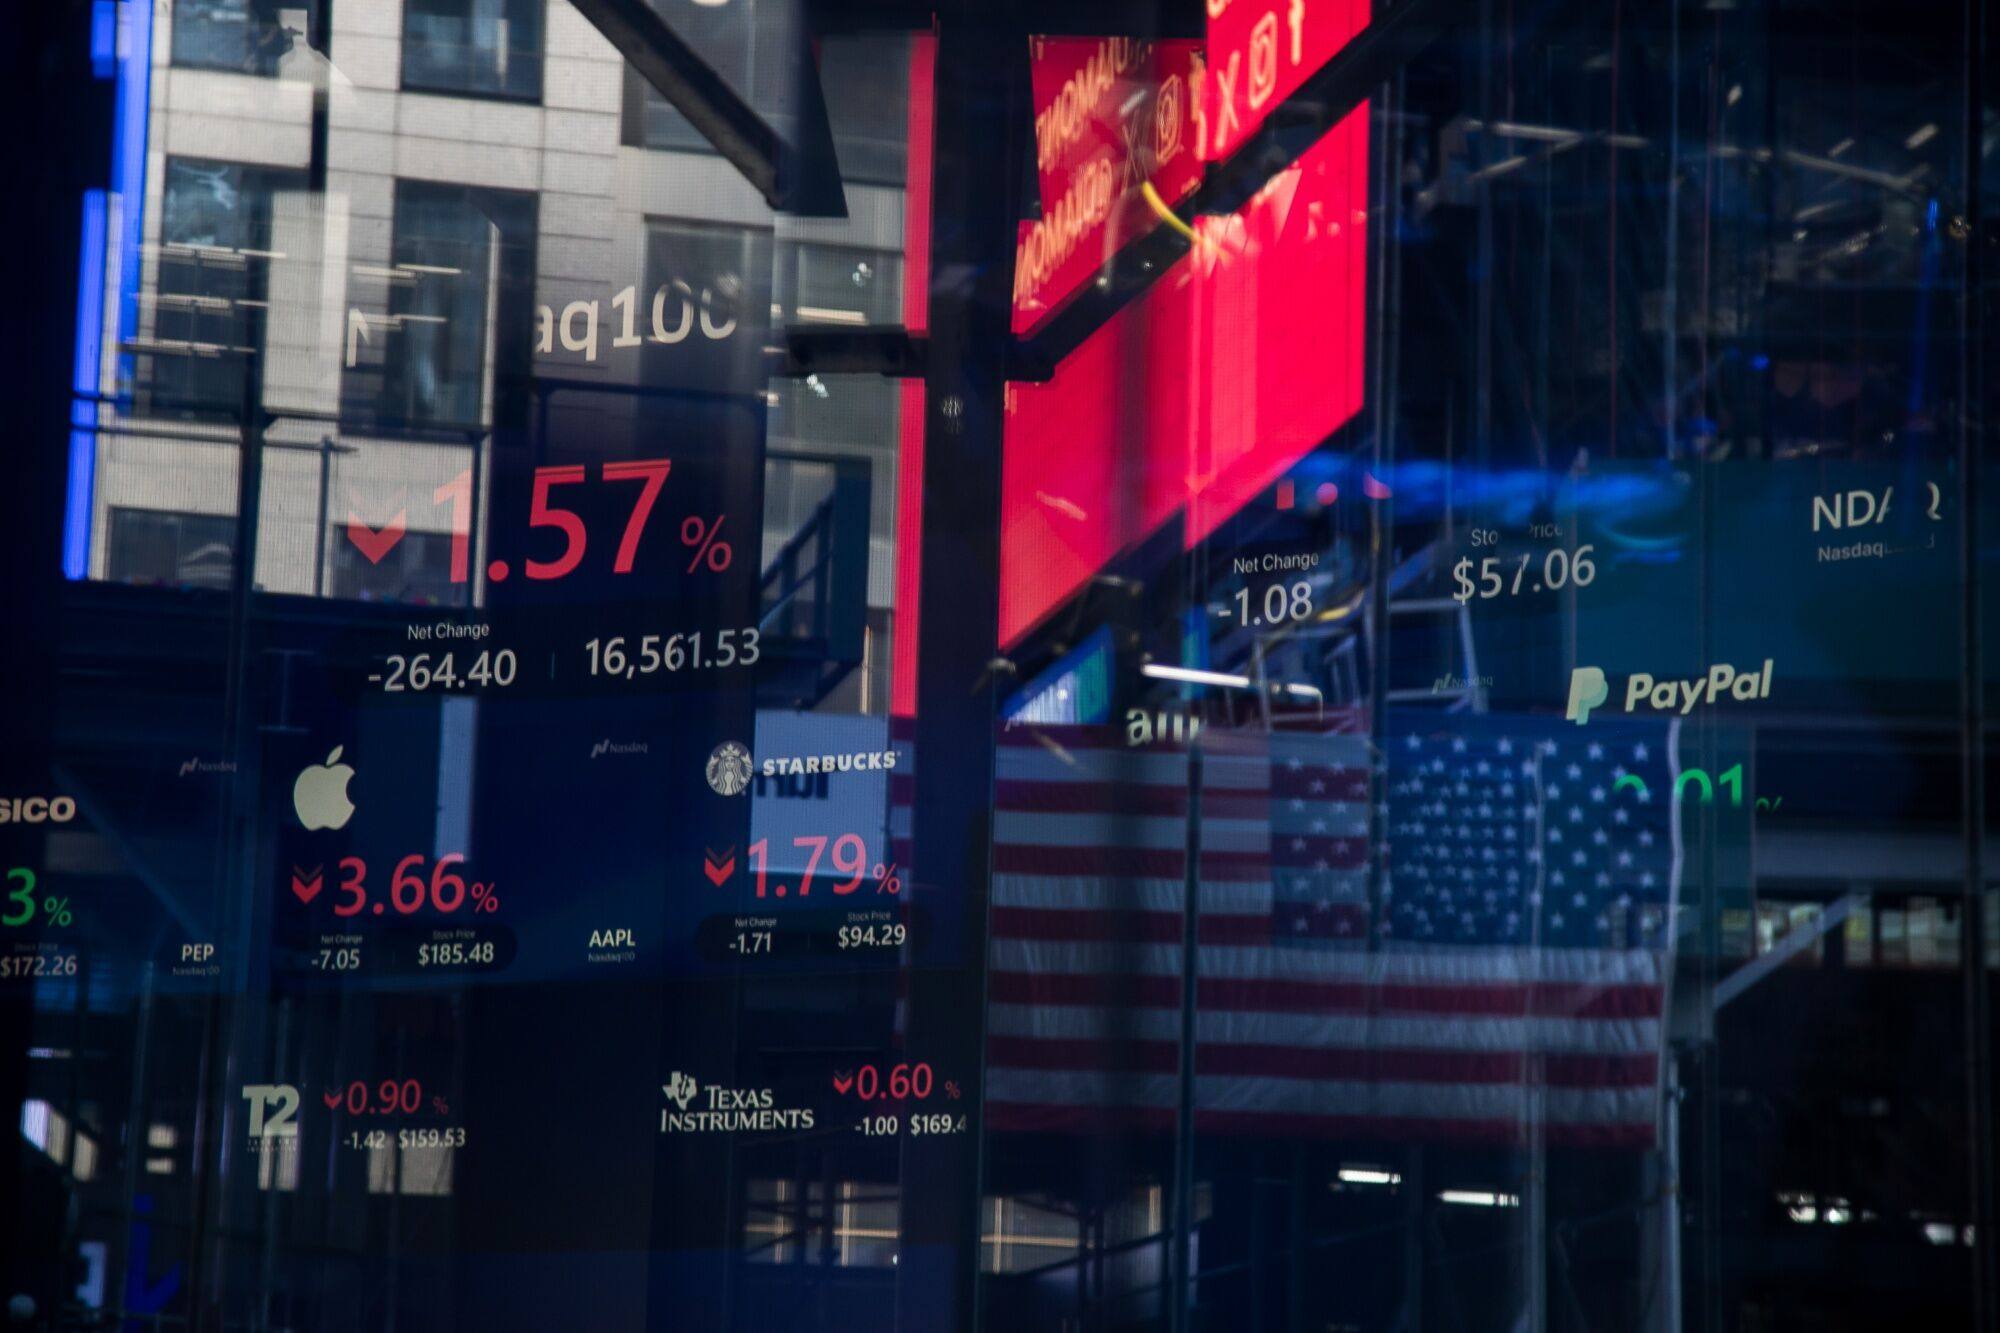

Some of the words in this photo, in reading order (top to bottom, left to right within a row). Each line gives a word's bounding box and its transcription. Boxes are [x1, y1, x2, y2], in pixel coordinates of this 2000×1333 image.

[1233, 556, 1259, 574] Net
[1262, 551, 1319, 571] Change
[1218, 581, 1313, 627] -1.08
[407, 624, 432, 640] Net
[435, 622, 490, 640] Change
[584, 626, 760, 680] 16,561.53
[367, 648, 517, 692] -264.40
[1625, 658, 1774, 715] PayPal
[762, 751, 896, 776] STARBUCKS
[749, 916, 777, 928] Change
[588, 928, 636, 948] AAPL
[728, 931, 772, 954] -1.71
[837, 924, 906, 951] $94.29
[181, 943, 215, 962] PEP
[311, 947, 360, 970] -7.05
[418, 940, 494, 968] $185.48
[0, 954, 77, 978] $172.26
[856, 1063, 933, 1100] 0.60
[346, 1078, 422, 1115] 0.90
[854, 1116, 898, 1136] -1.00
[343, 1131, 386, 1150] -1.42
[398, 1127, 467, 1150] $159.53
